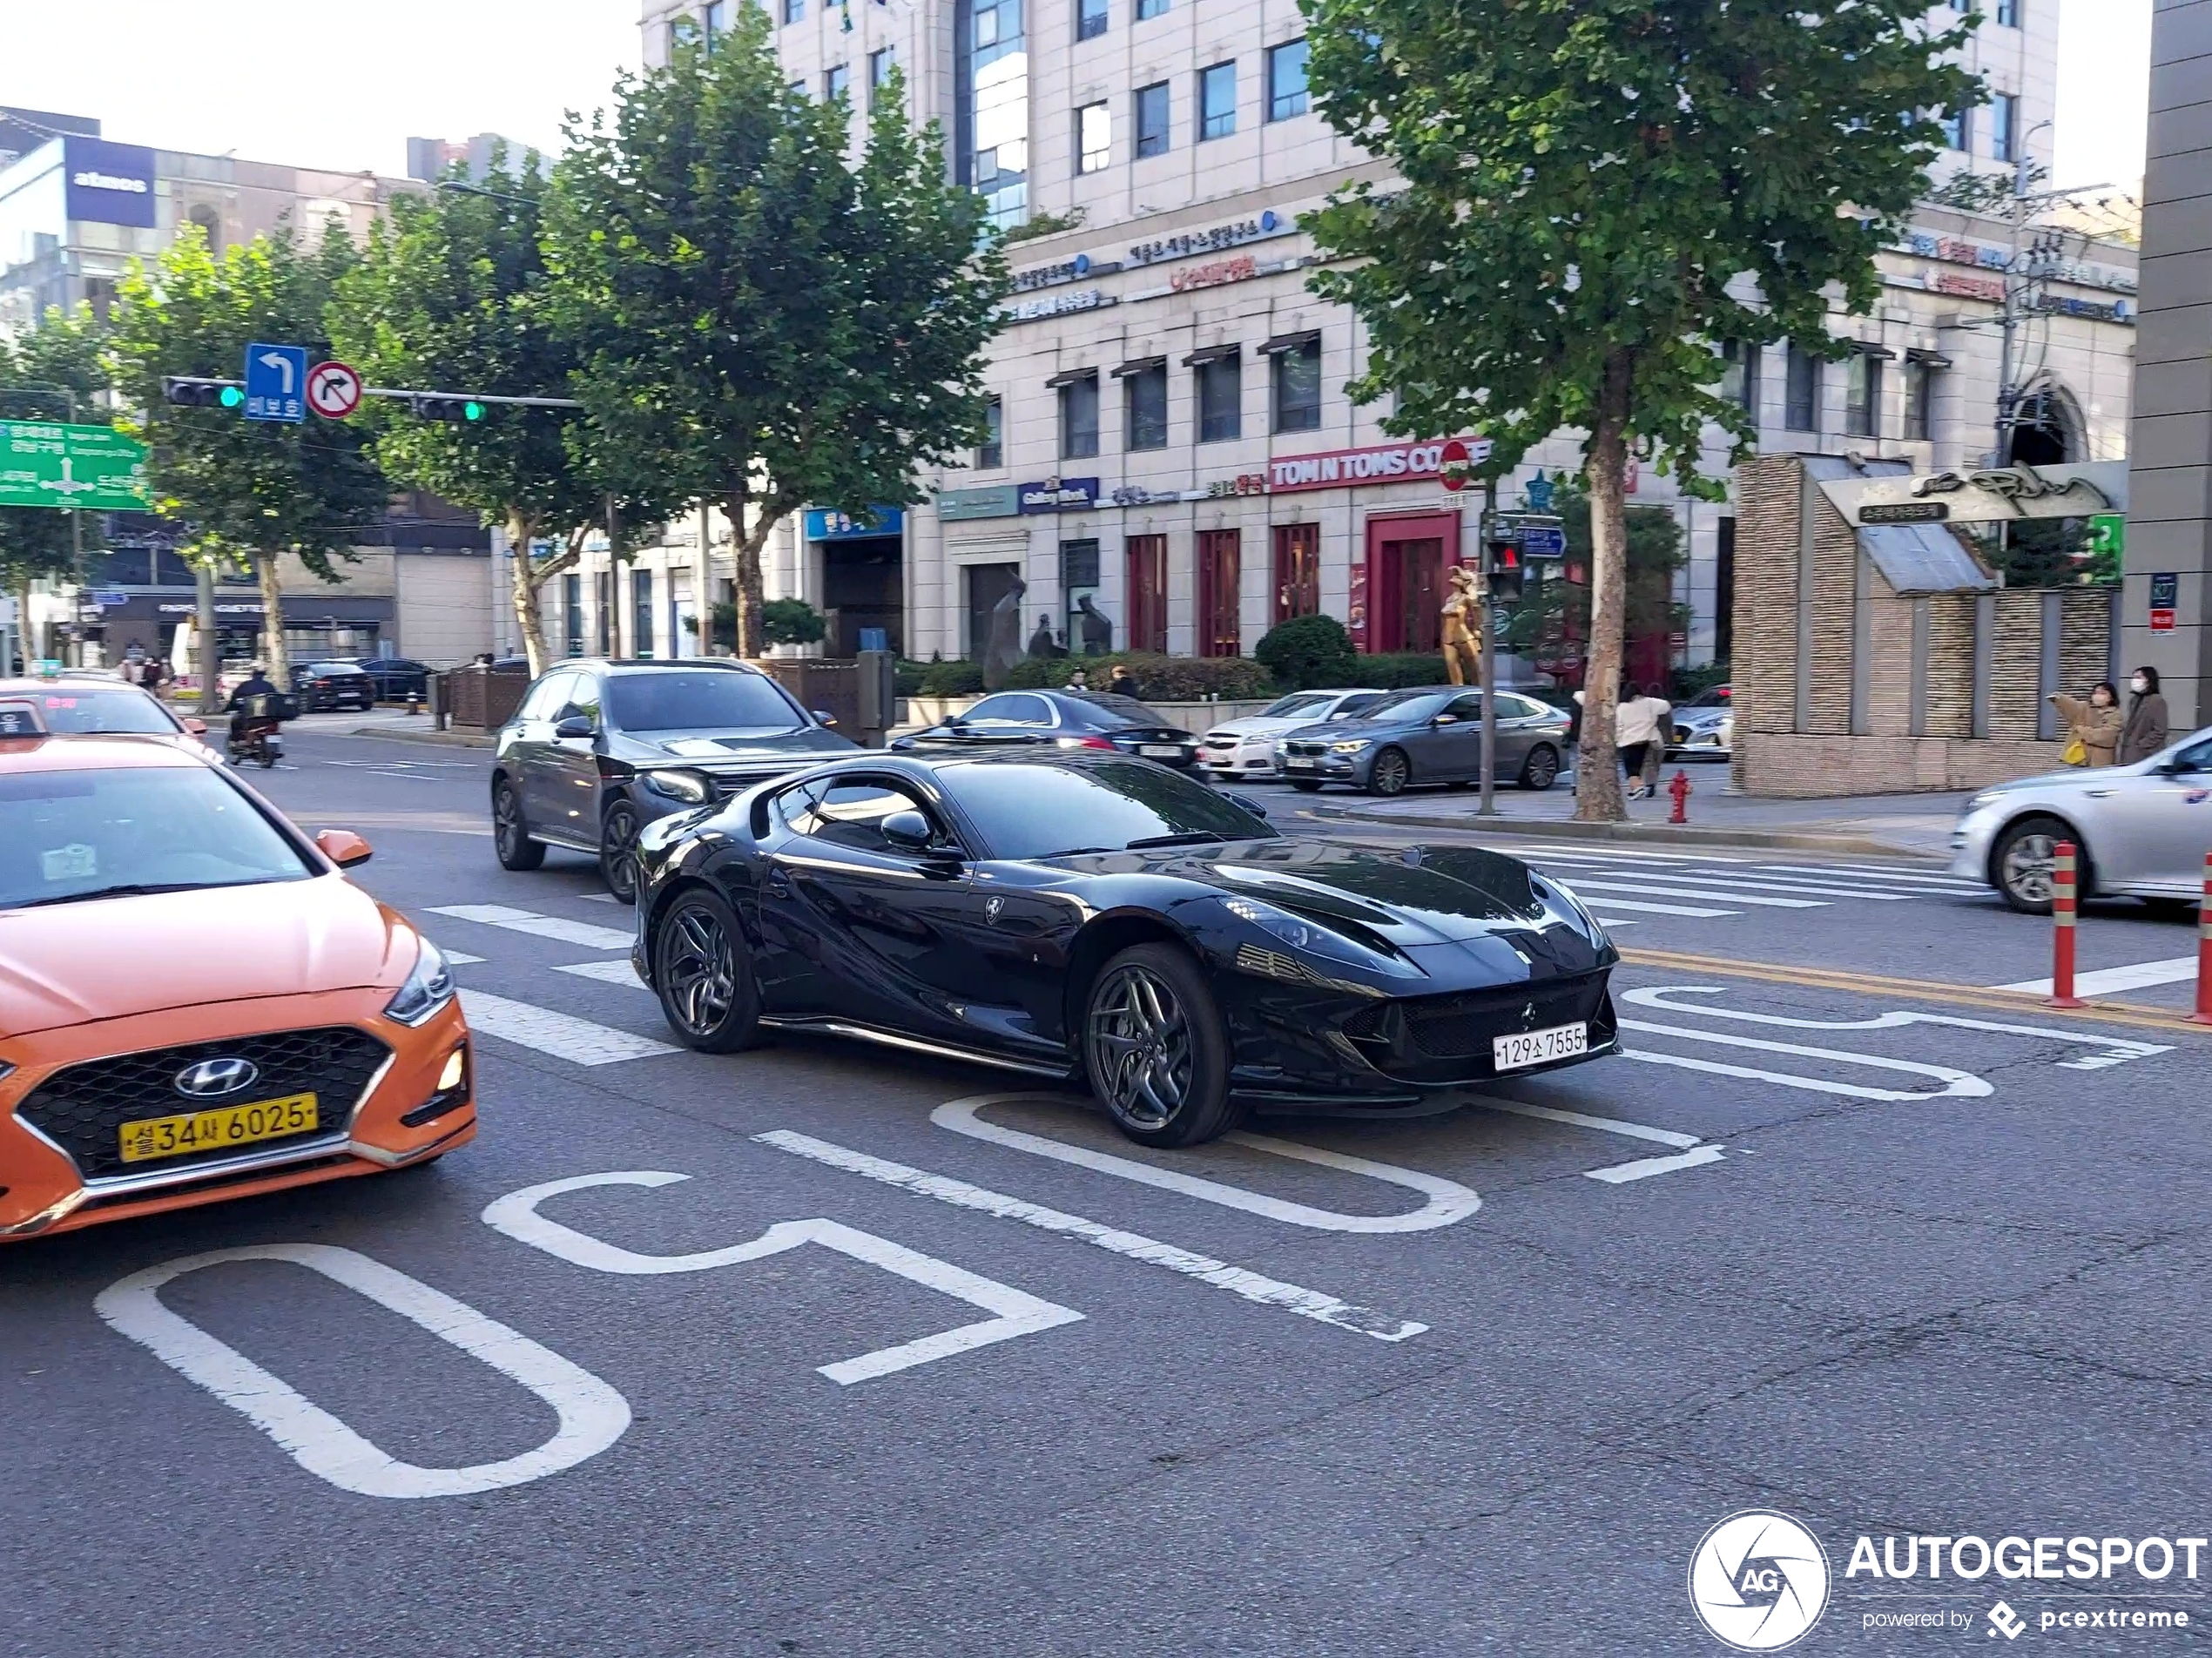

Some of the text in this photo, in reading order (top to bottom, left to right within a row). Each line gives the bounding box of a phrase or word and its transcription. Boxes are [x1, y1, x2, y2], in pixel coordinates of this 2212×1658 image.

[1271, 459, 1319, 485] TOM
[1321, 457, 1339, 482] N
[1339, 449, 1407, 479] TOMS
[1502, 1028, 1582, 1064] 129소 7555
[227, 1102, 304, 1139] 6025
